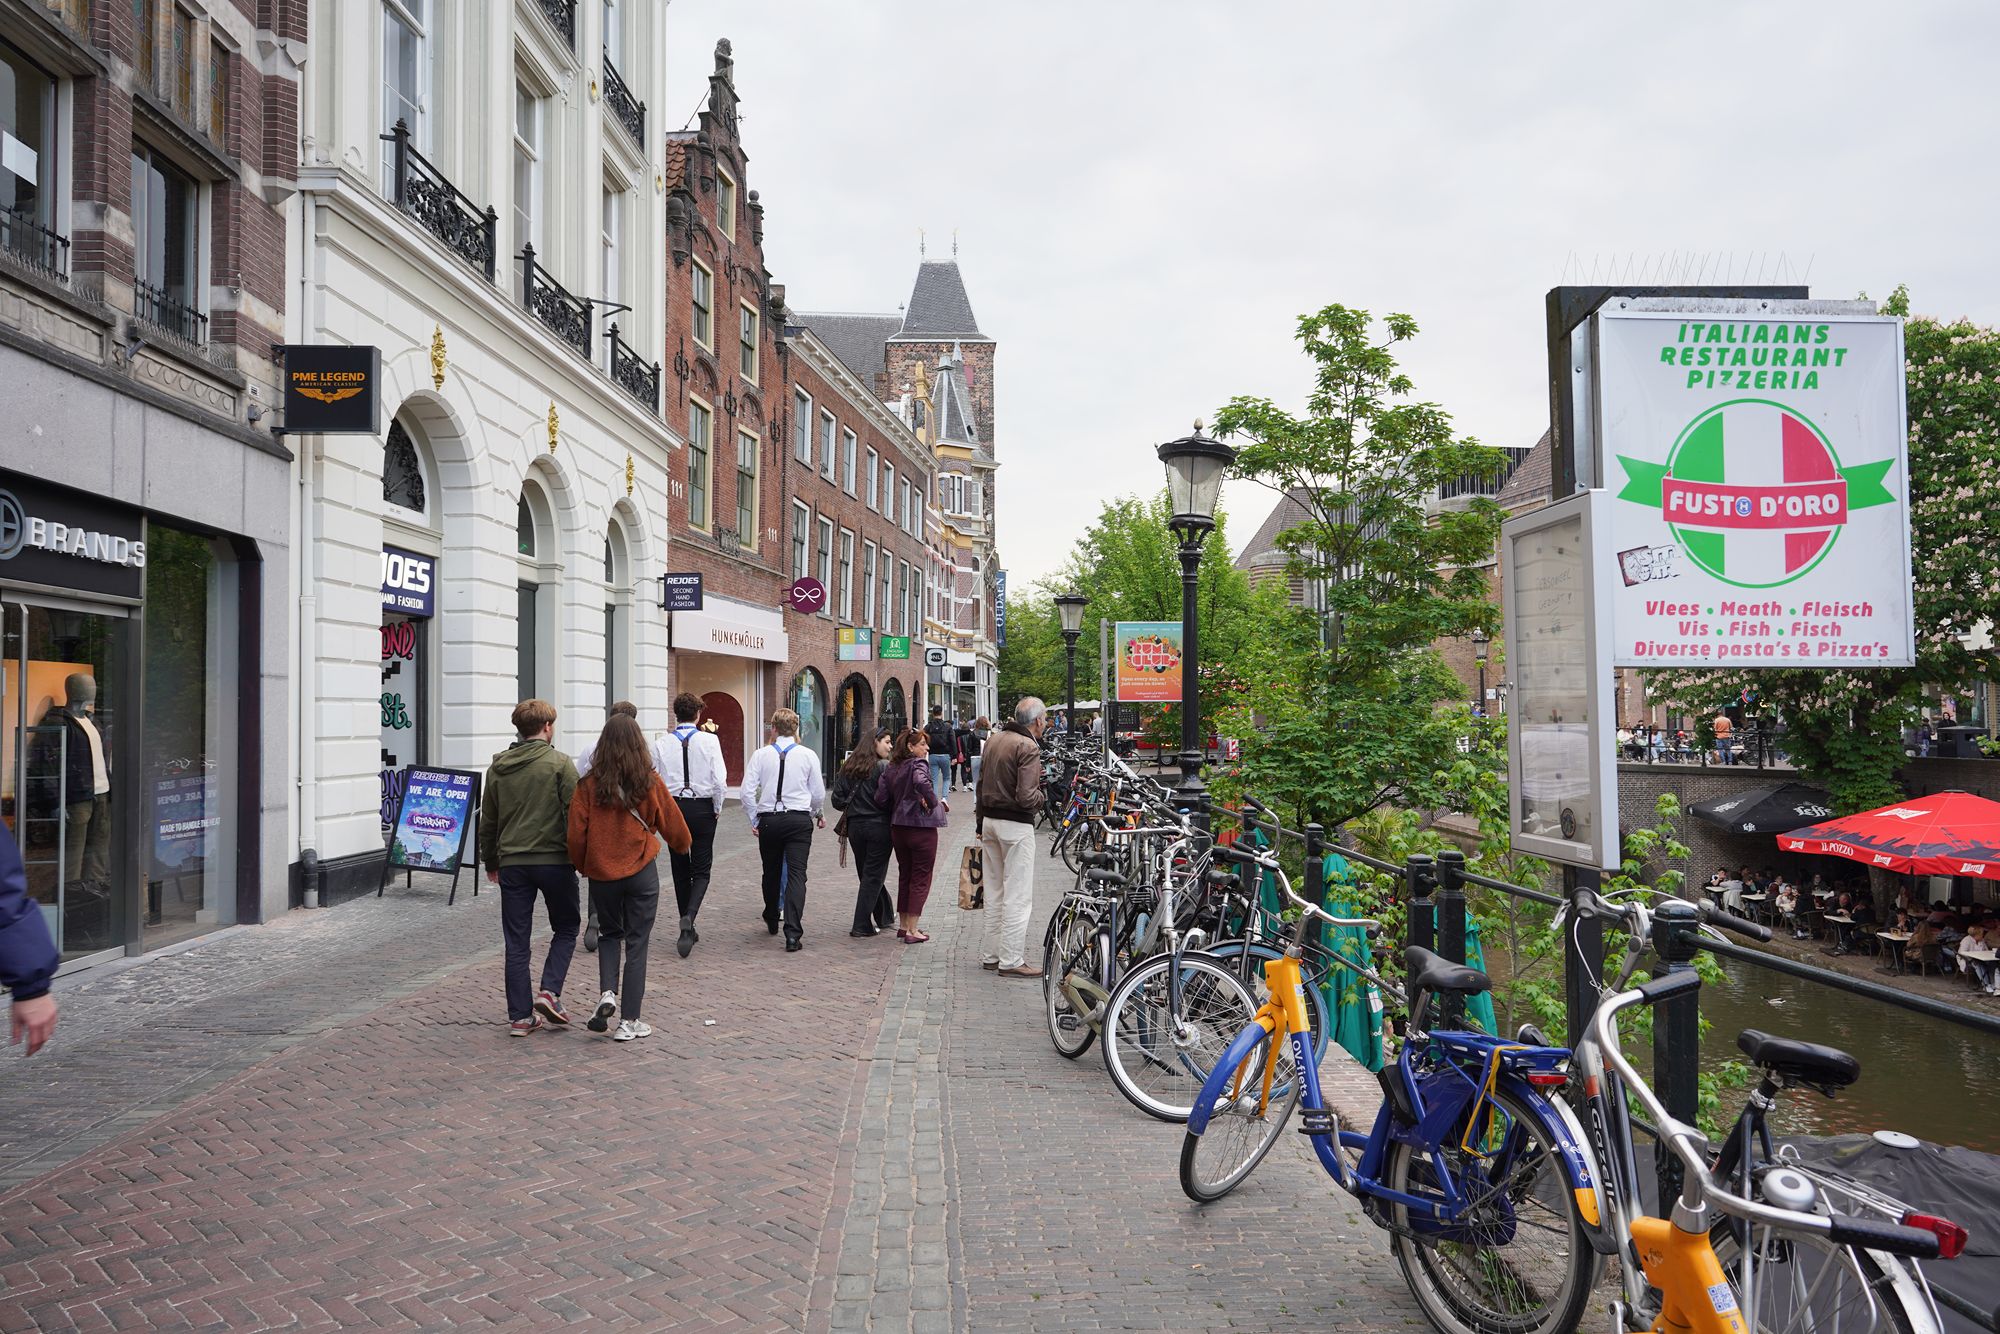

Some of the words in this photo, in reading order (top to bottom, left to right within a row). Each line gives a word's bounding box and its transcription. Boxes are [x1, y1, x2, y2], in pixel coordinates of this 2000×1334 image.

[1678, 324, 1830, 344] ITALIAANS
[1660, 347, 1848, 367] RESTAURANT
[292, 372, 318, 381] PME
[320, 372, 365, 381] LEGEND
[1687, 370, 1818, 389] PIZZERIA
[671, 479, 683, 499] 111
[1760, 493, 1840, 517] D'ORO
[25, 516, 146, 567] BRANDS
[767, 527, 778, 542] 111
[666, 576, 699, 585] REJOES
[397, 596, 424, 610] FASHION
[996, 578, 1005, 628] OUDAEN
[1645, 601, 1700, 616] Vlees
[1720, 601, 1782, 616] Meath
[1802, 602, 1873, 617] Fleisch
[1678, 621, 1709, 636] Vis
[1729, 621, 1770, 636] Fish
[1791, 622, 1842, 637] Fisch
[711, 628, 764, 650] HUNKEMÖLLER
[1133, 643, 1162, 654] RUM
[1634, 641, 1711, 656] Diverse
[1717, 641, 1790, 659] pasta's
[1797, 642, 1810, 657] &
[1817, 641, 1889, 657] Pizza's
[409, 785, 423, 795] WE
[425, 788, 443, 797] ARE
[446, 790, 468, 800] OPEN
[1792, 804, 1833, 818] Leffe
[160, 823, 175, 834] MADE
[175, 822, 182, 832] TO
[182, 819, 201, 831] HANDLE
[1829, 842, 1854, 856] POZZO
[1292, 1040, 1308, 1097] OV-fiets
[1591, 1107, 1616, 1213] Gazelle
